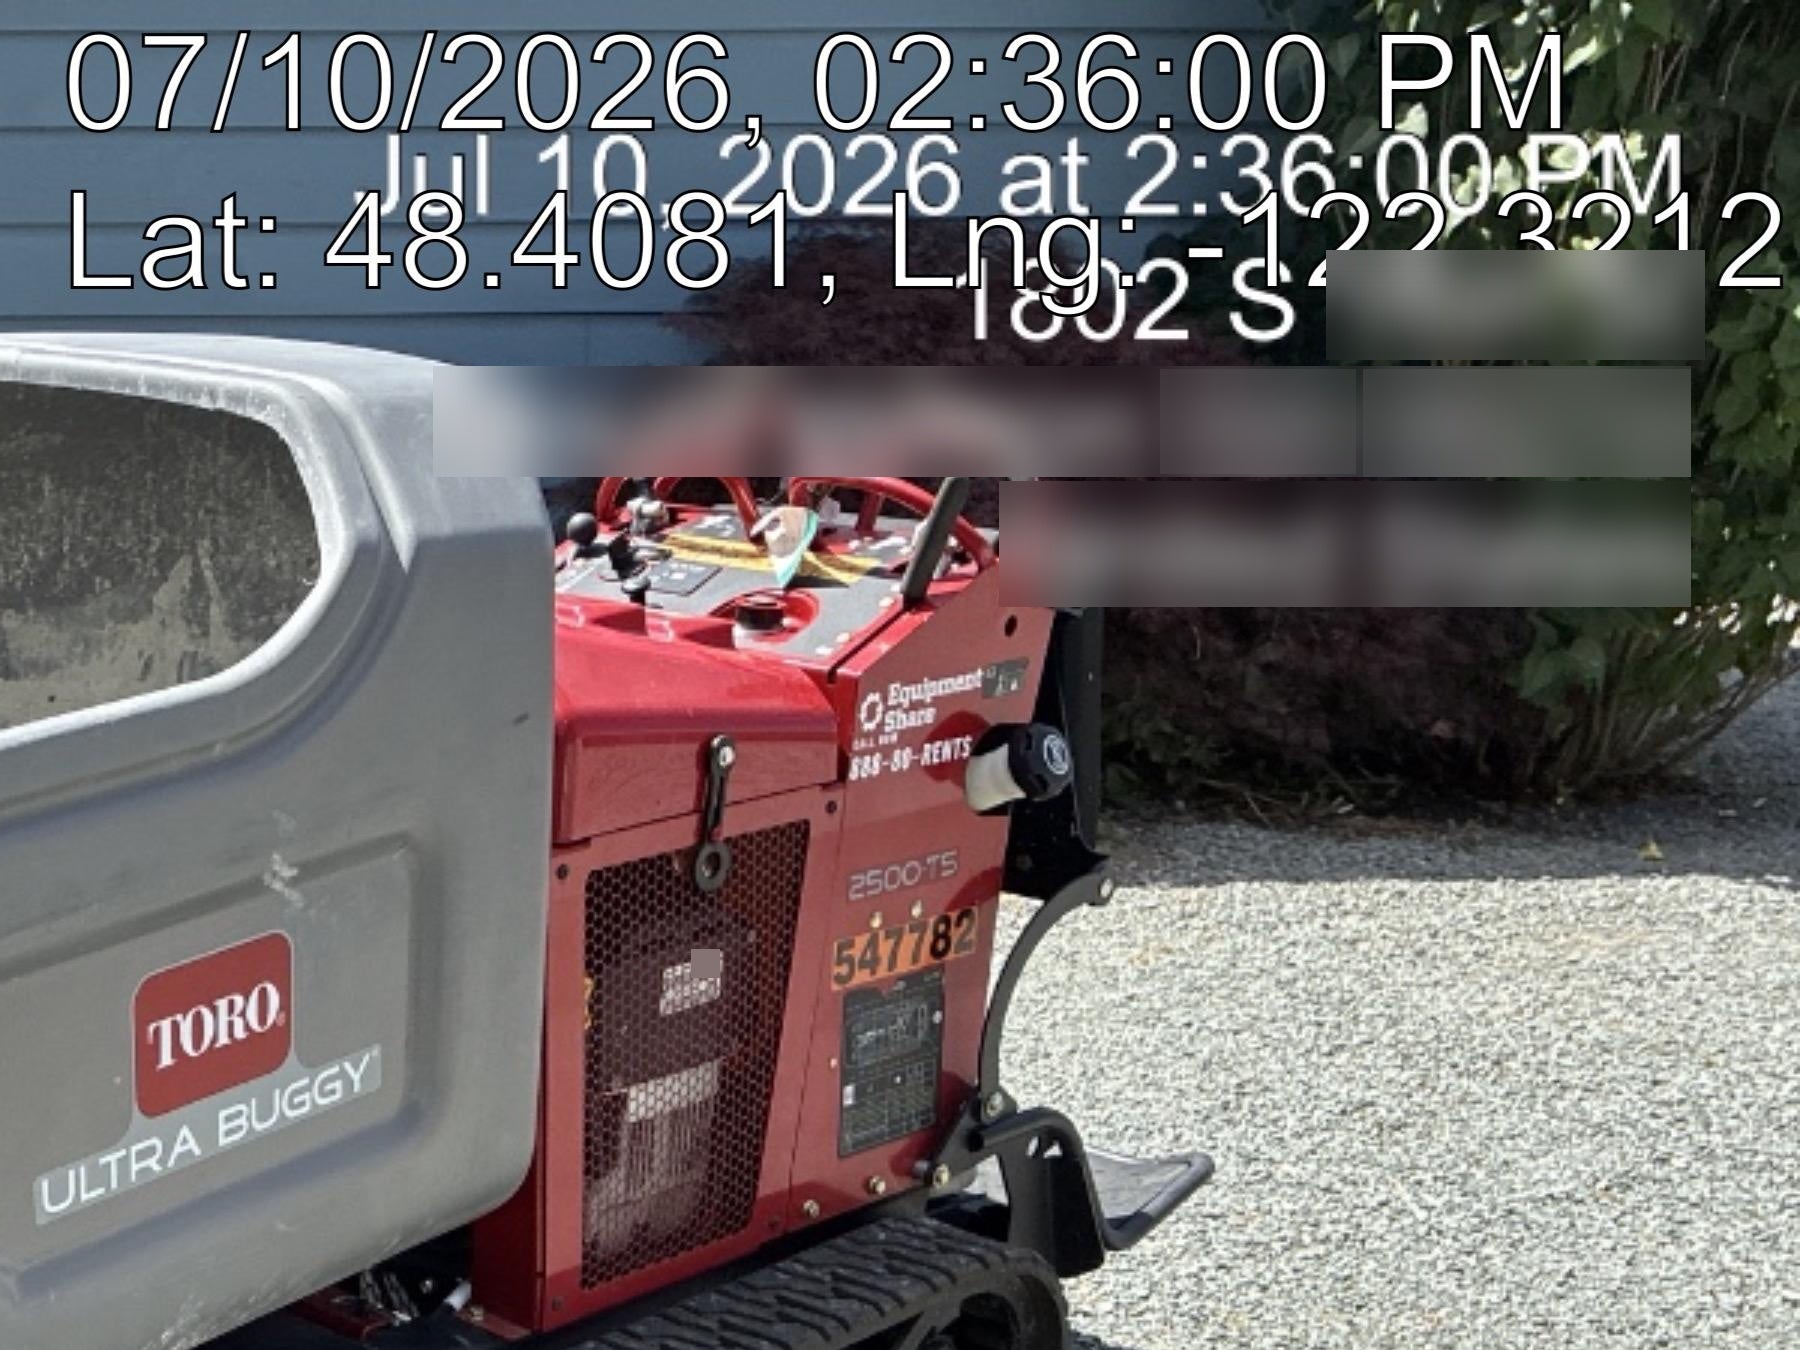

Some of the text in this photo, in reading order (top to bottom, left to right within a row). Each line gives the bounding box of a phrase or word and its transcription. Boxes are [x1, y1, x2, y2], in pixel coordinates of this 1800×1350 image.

[884, 708, 937, 732] Share
[888, 668, 982, 706] Equipment
[832, 908, 976, 985] 547782
[147, 981, 281, 1072] TORO
[41, 1052, 372, 1213] ULTRA BUGGY
